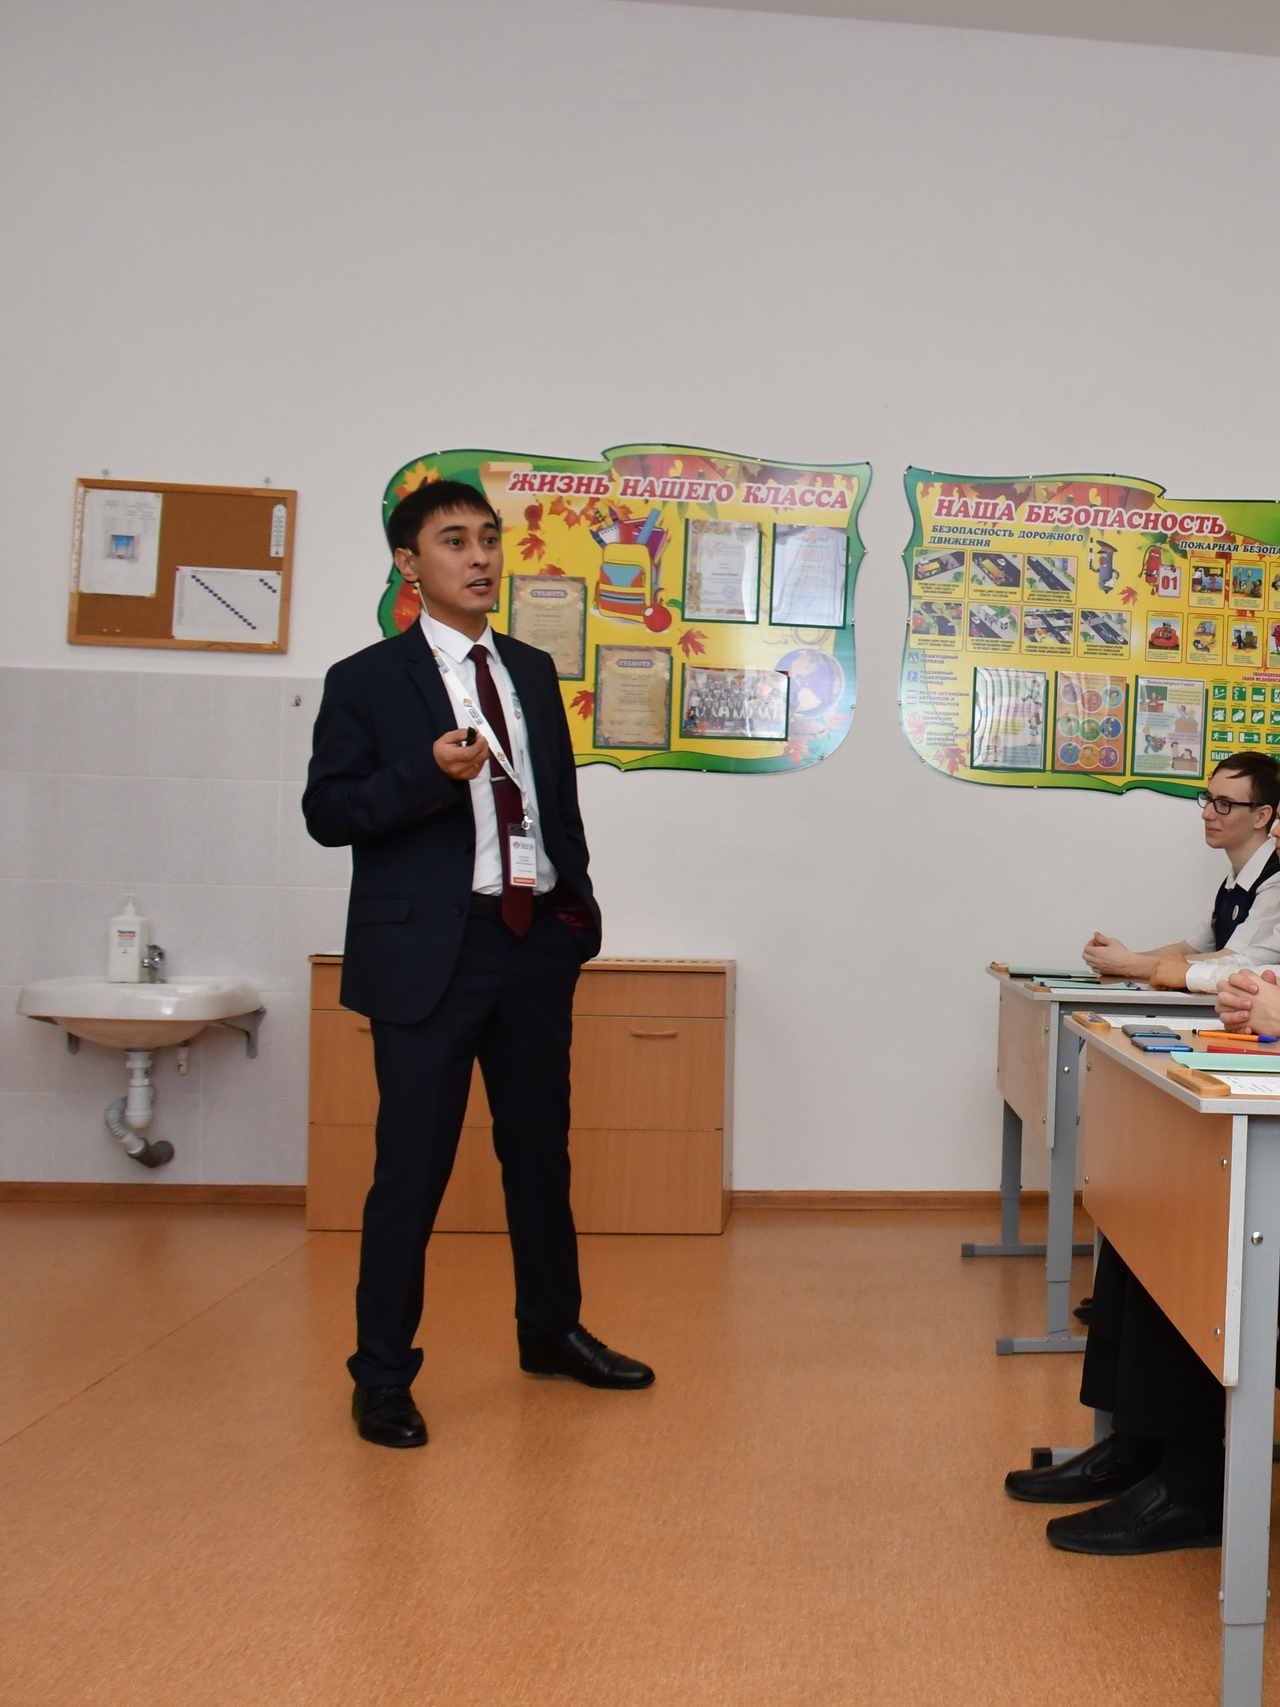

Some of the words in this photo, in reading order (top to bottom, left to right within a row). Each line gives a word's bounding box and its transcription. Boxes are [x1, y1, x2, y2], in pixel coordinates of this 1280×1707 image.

[509, 472, 610, 495] ЖИЗНЬ
[620, 477, 734, 502] НАШЕГО
[743, 486, 849, 509] КЛАССА
[935, 499, 1015, 522] НАША
[1025, 503, 1225, 535] БЕЗОПАСНОСТЬ
[931, 524, 1015, 539] БЕЗОПАСНОСТЬ
[1018, 530, 1084, 543] ДОРОЖНОГО
[929, 536, 991, 548] ДВИЖЕНИЯ
[1180, 540, 1239, 553] ПОЖАРНАЯ
[1161, 575, 1178, 590] 01
[532, 590, 566, 598] ГРАМОТА
[618, 660, 652, 668] ГРАМОТА
